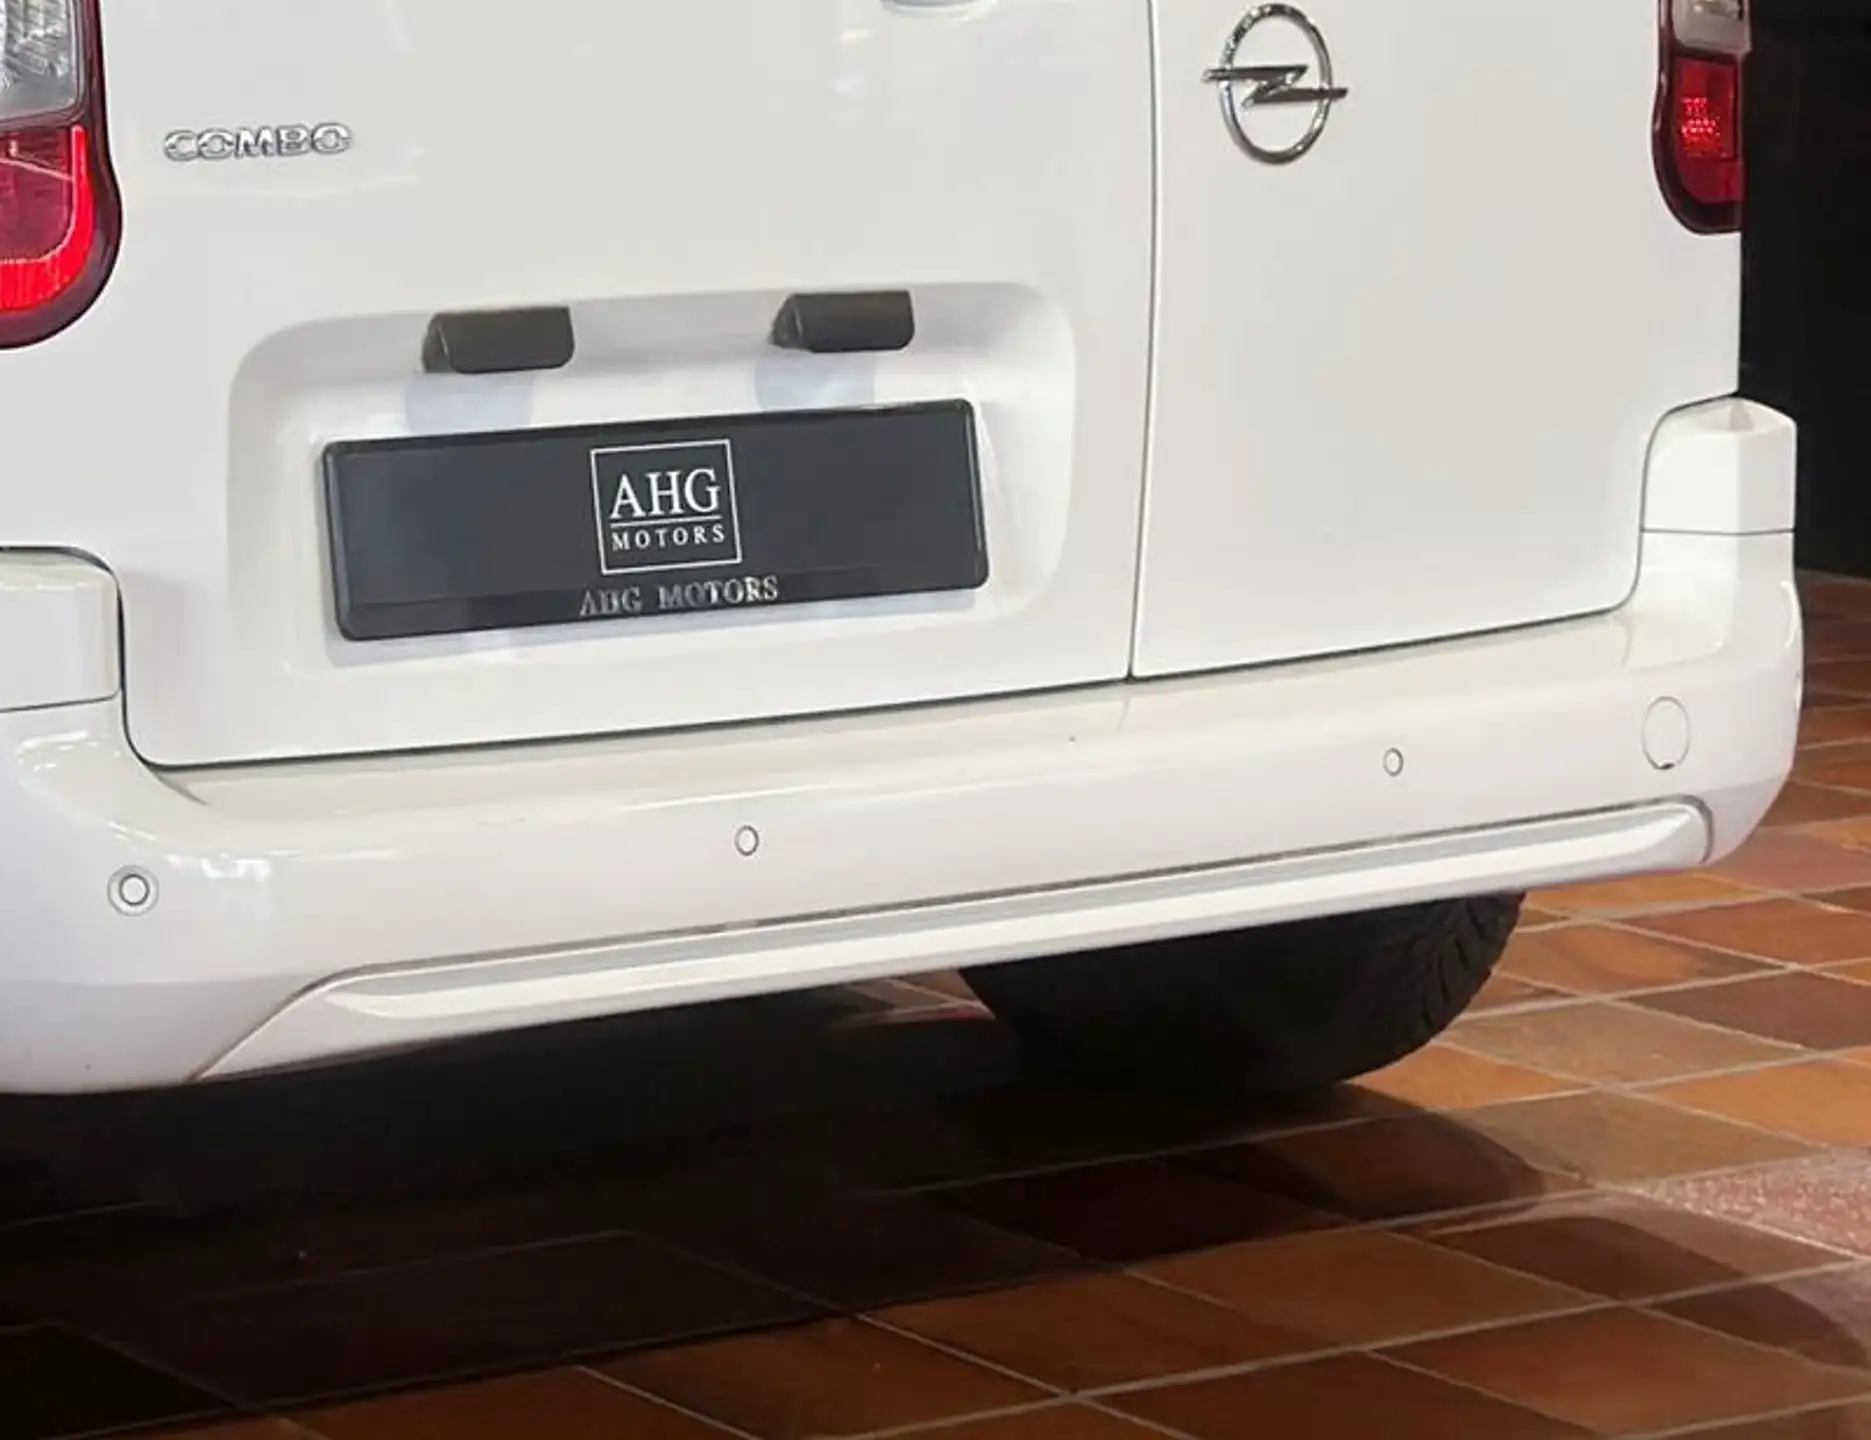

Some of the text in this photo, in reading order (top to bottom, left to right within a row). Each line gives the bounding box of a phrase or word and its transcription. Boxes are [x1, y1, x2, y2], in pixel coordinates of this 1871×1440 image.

[163, 121, 353, 162] COMBO
[609, 467, 721, 519] AHG
[612, 524, 726, 551] MOTORS
[658, 575, 779, 609] MOTORS
